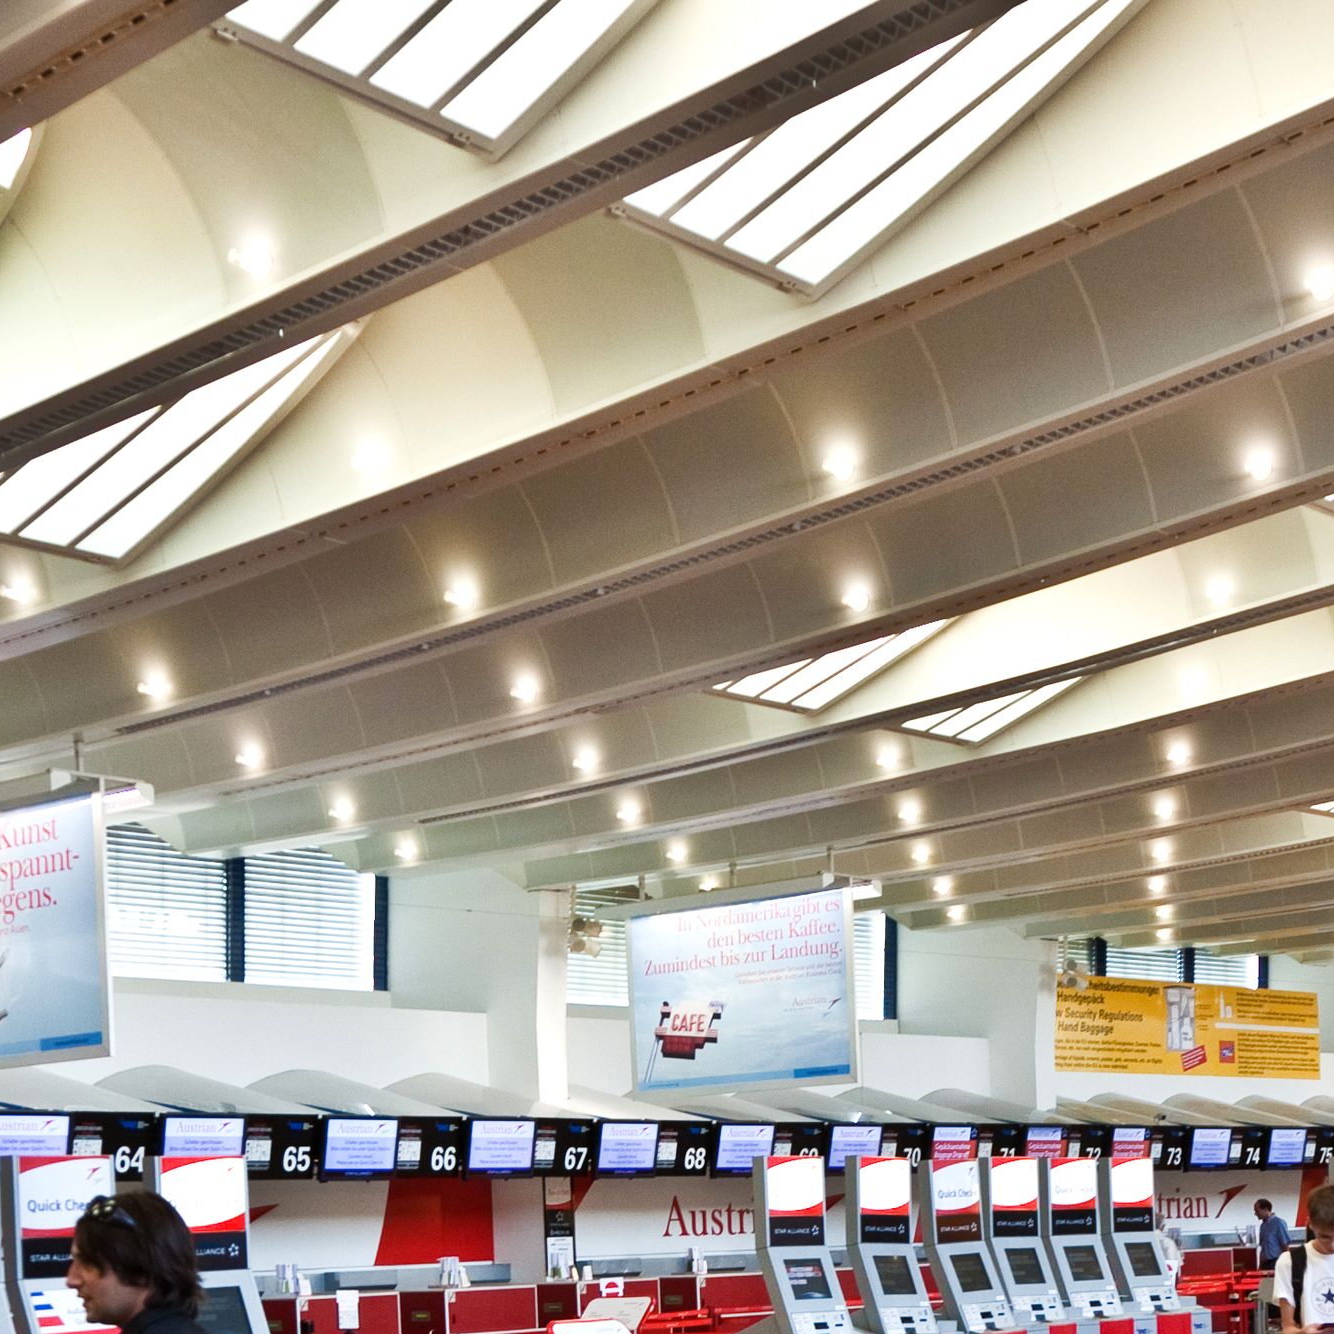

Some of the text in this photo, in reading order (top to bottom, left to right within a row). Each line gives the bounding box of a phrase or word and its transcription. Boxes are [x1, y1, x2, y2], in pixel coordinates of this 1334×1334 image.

[825, 900, 840, 914] es
[707, 918, 840, 949] den besten Kaffee.
[644, 951, 717, 977] Zumindest
[720, 948, 740, 967] bis
[743, 948, 767, 964] zur
[771, 940, 842, 961] Landung.
[671, 1013, 706, 1032] CAFE
[1064, 1007, 1097, 1021] Security
[1098, 1009, 1144, 1023] Regulations
[1058, 1021, 1114, 1036] Hand Baggage
[115, 1146, 145, 1173] 64
[282, 1145, 311, 1172] 65
[431, 1146, 457, 1171] 66
[564, 1146, 588, 1170] 67
[684, 1147, 706, 1170] 68
[903, 1147, 922, 1168] 70
[1167, 1147, 1182, 1165] 73
[1246, 1147, 1260, 1165] 74
[1319, 1147, 1333, 1163] 75
[27, 1199, 61, 1213] Quick
[1158, 1187, 1209, 1219] trian
[662, 1194, 756, 1237] Austri
[30, 1253, 51, 1262] STAR
